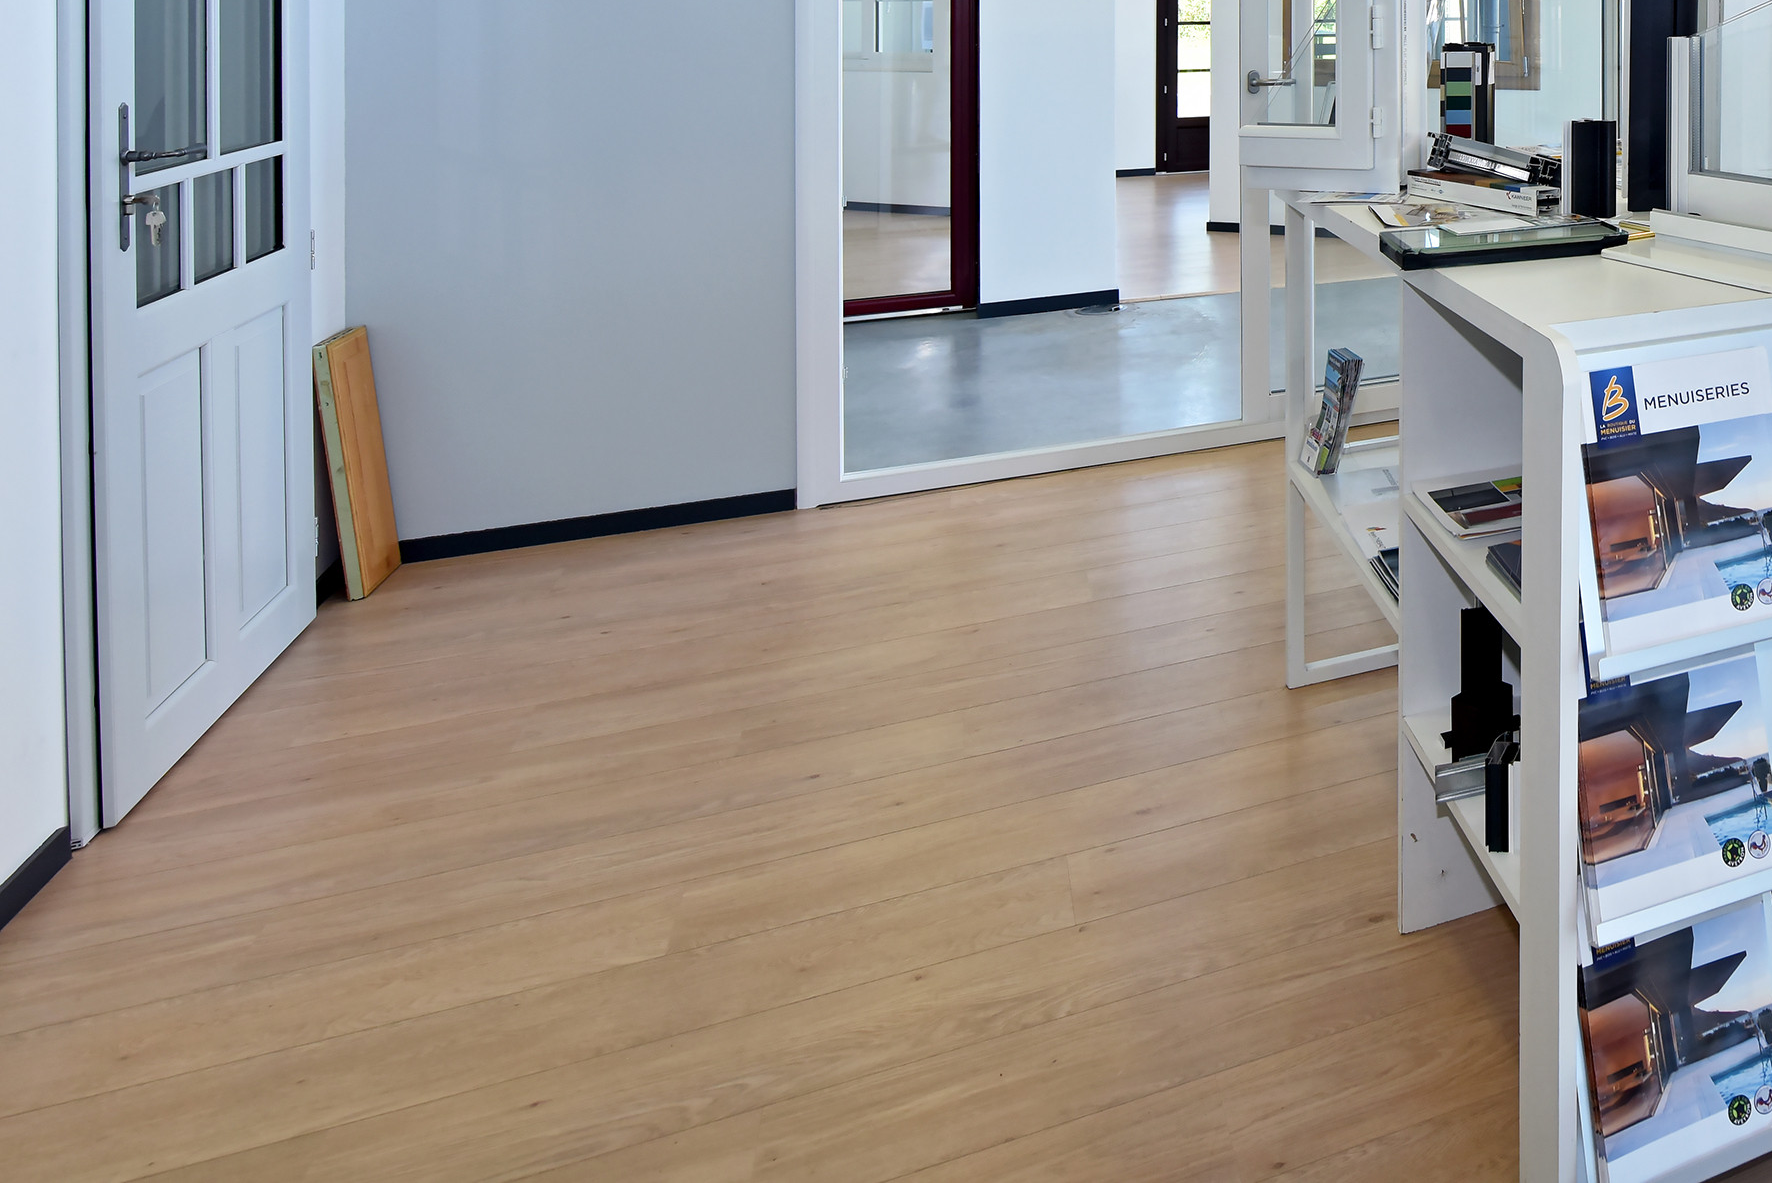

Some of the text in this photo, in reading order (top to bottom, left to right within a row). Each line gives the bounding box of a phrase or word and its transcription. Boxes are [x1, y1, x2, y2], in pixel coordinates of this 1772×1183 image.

[1602, 375, 1630, 422] B
[1643, 382, 1750, 411] MENUISERIES
[1600, 424, 1636, 435] MENUISIER
